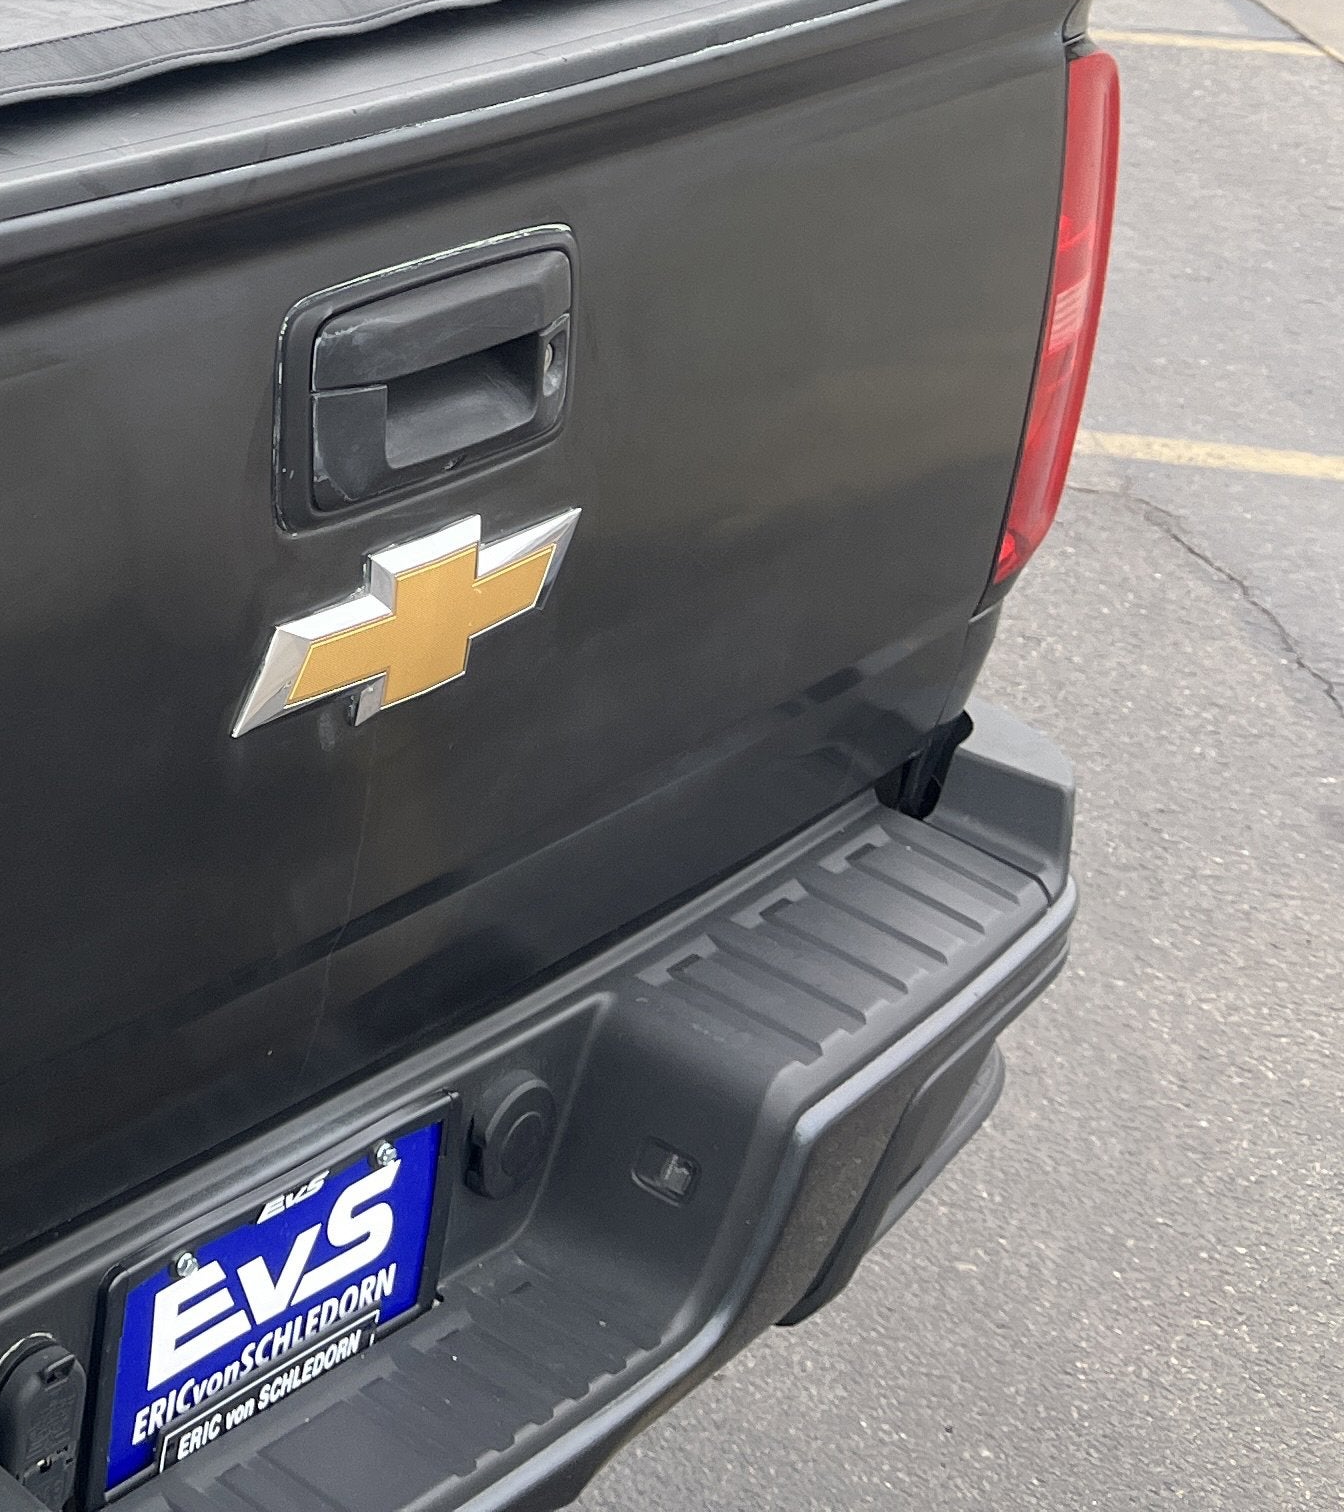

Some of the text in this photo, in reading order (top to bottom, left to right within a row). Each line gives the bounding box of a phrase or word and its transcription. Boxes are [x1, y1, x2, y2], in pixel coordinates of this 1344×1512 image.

[177, 1329, 362, 1462] ERIC von SCHLEDORN
